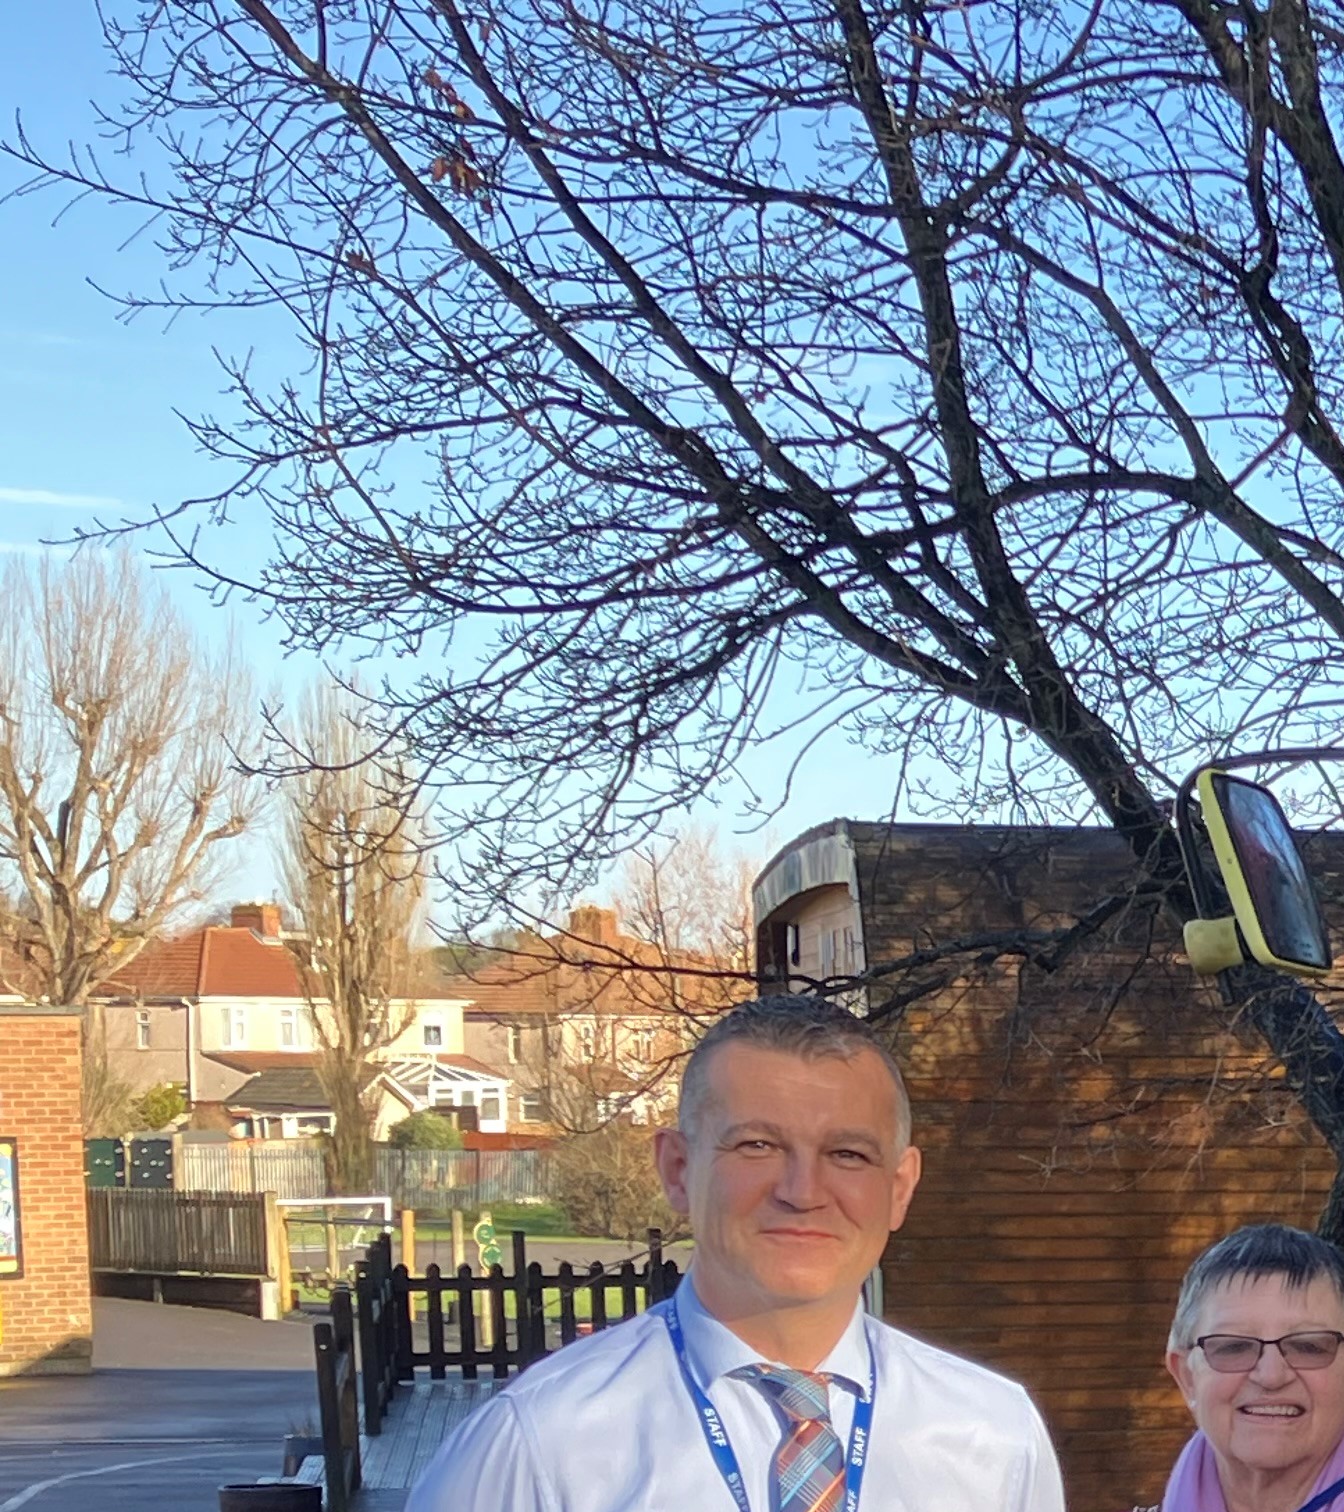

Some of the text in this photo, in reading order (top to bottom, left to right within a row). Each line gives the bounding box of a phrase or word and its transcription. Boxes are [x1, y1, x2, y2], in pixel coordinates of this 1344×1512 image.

[703, 1407, 728, 1448] STAFF
[851, 1426, 868, 1467] STAFF
[726, 1472, 749, 1512] STAFF
